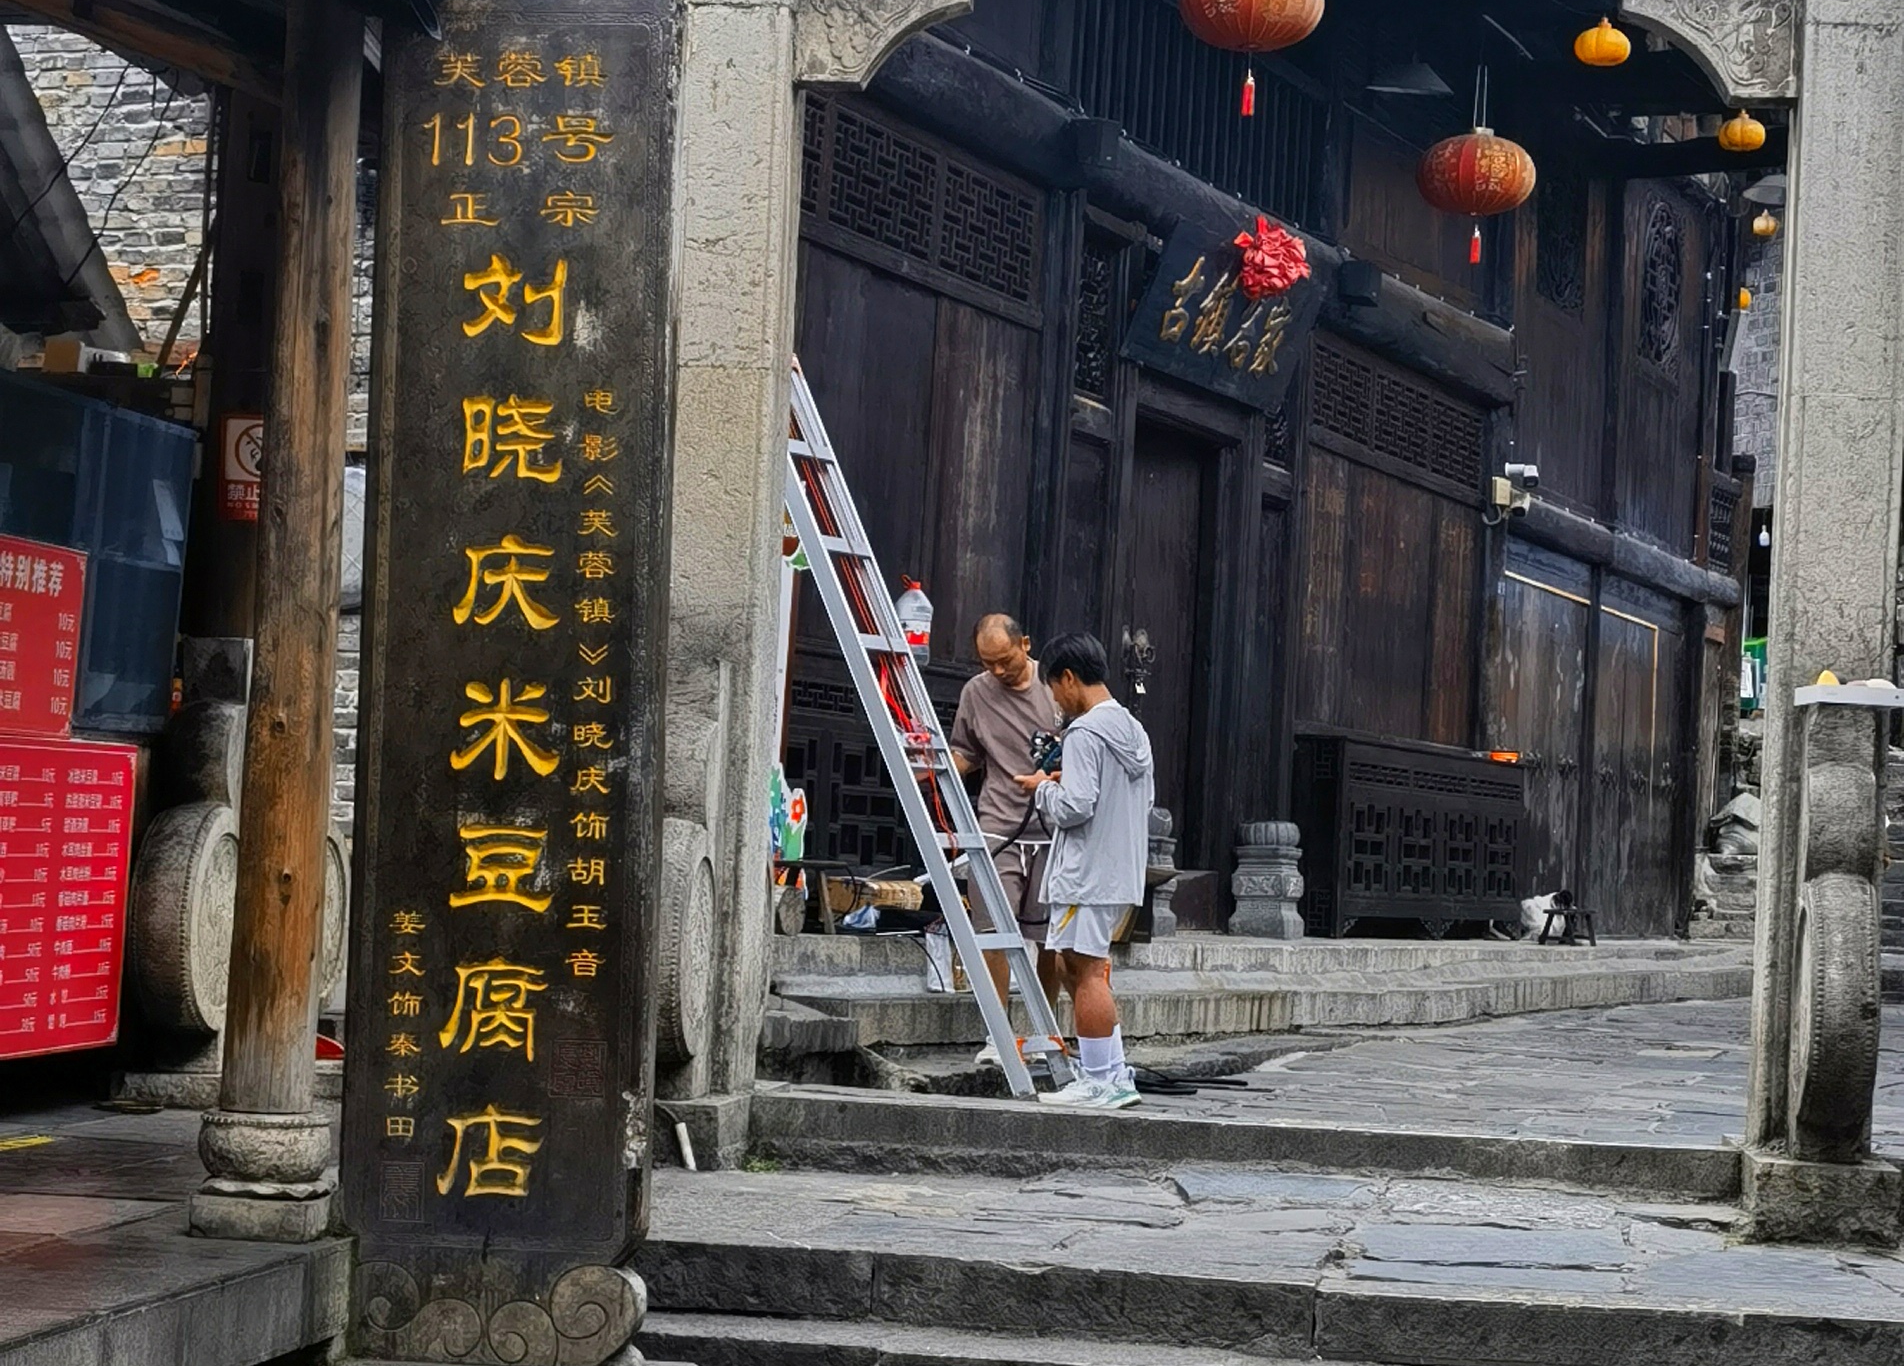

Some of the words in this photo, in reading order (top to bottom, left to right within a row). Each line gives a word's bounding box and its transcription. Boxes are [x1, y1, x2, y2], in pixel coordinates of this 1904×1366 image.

[422, 110, 616, 166] 113号
[433, 52, 608, 88] 芙蓉镇
[440, 190, 600, 228] 正宗
[436, 254, 568, 1198] 刘晓庆米豆腐店
[563, 388, 619, 978] 电影《芙蓉镇》刘晓庆饰胡玉音
[384, 911, 426, 1138] 姜文饰秦书田
